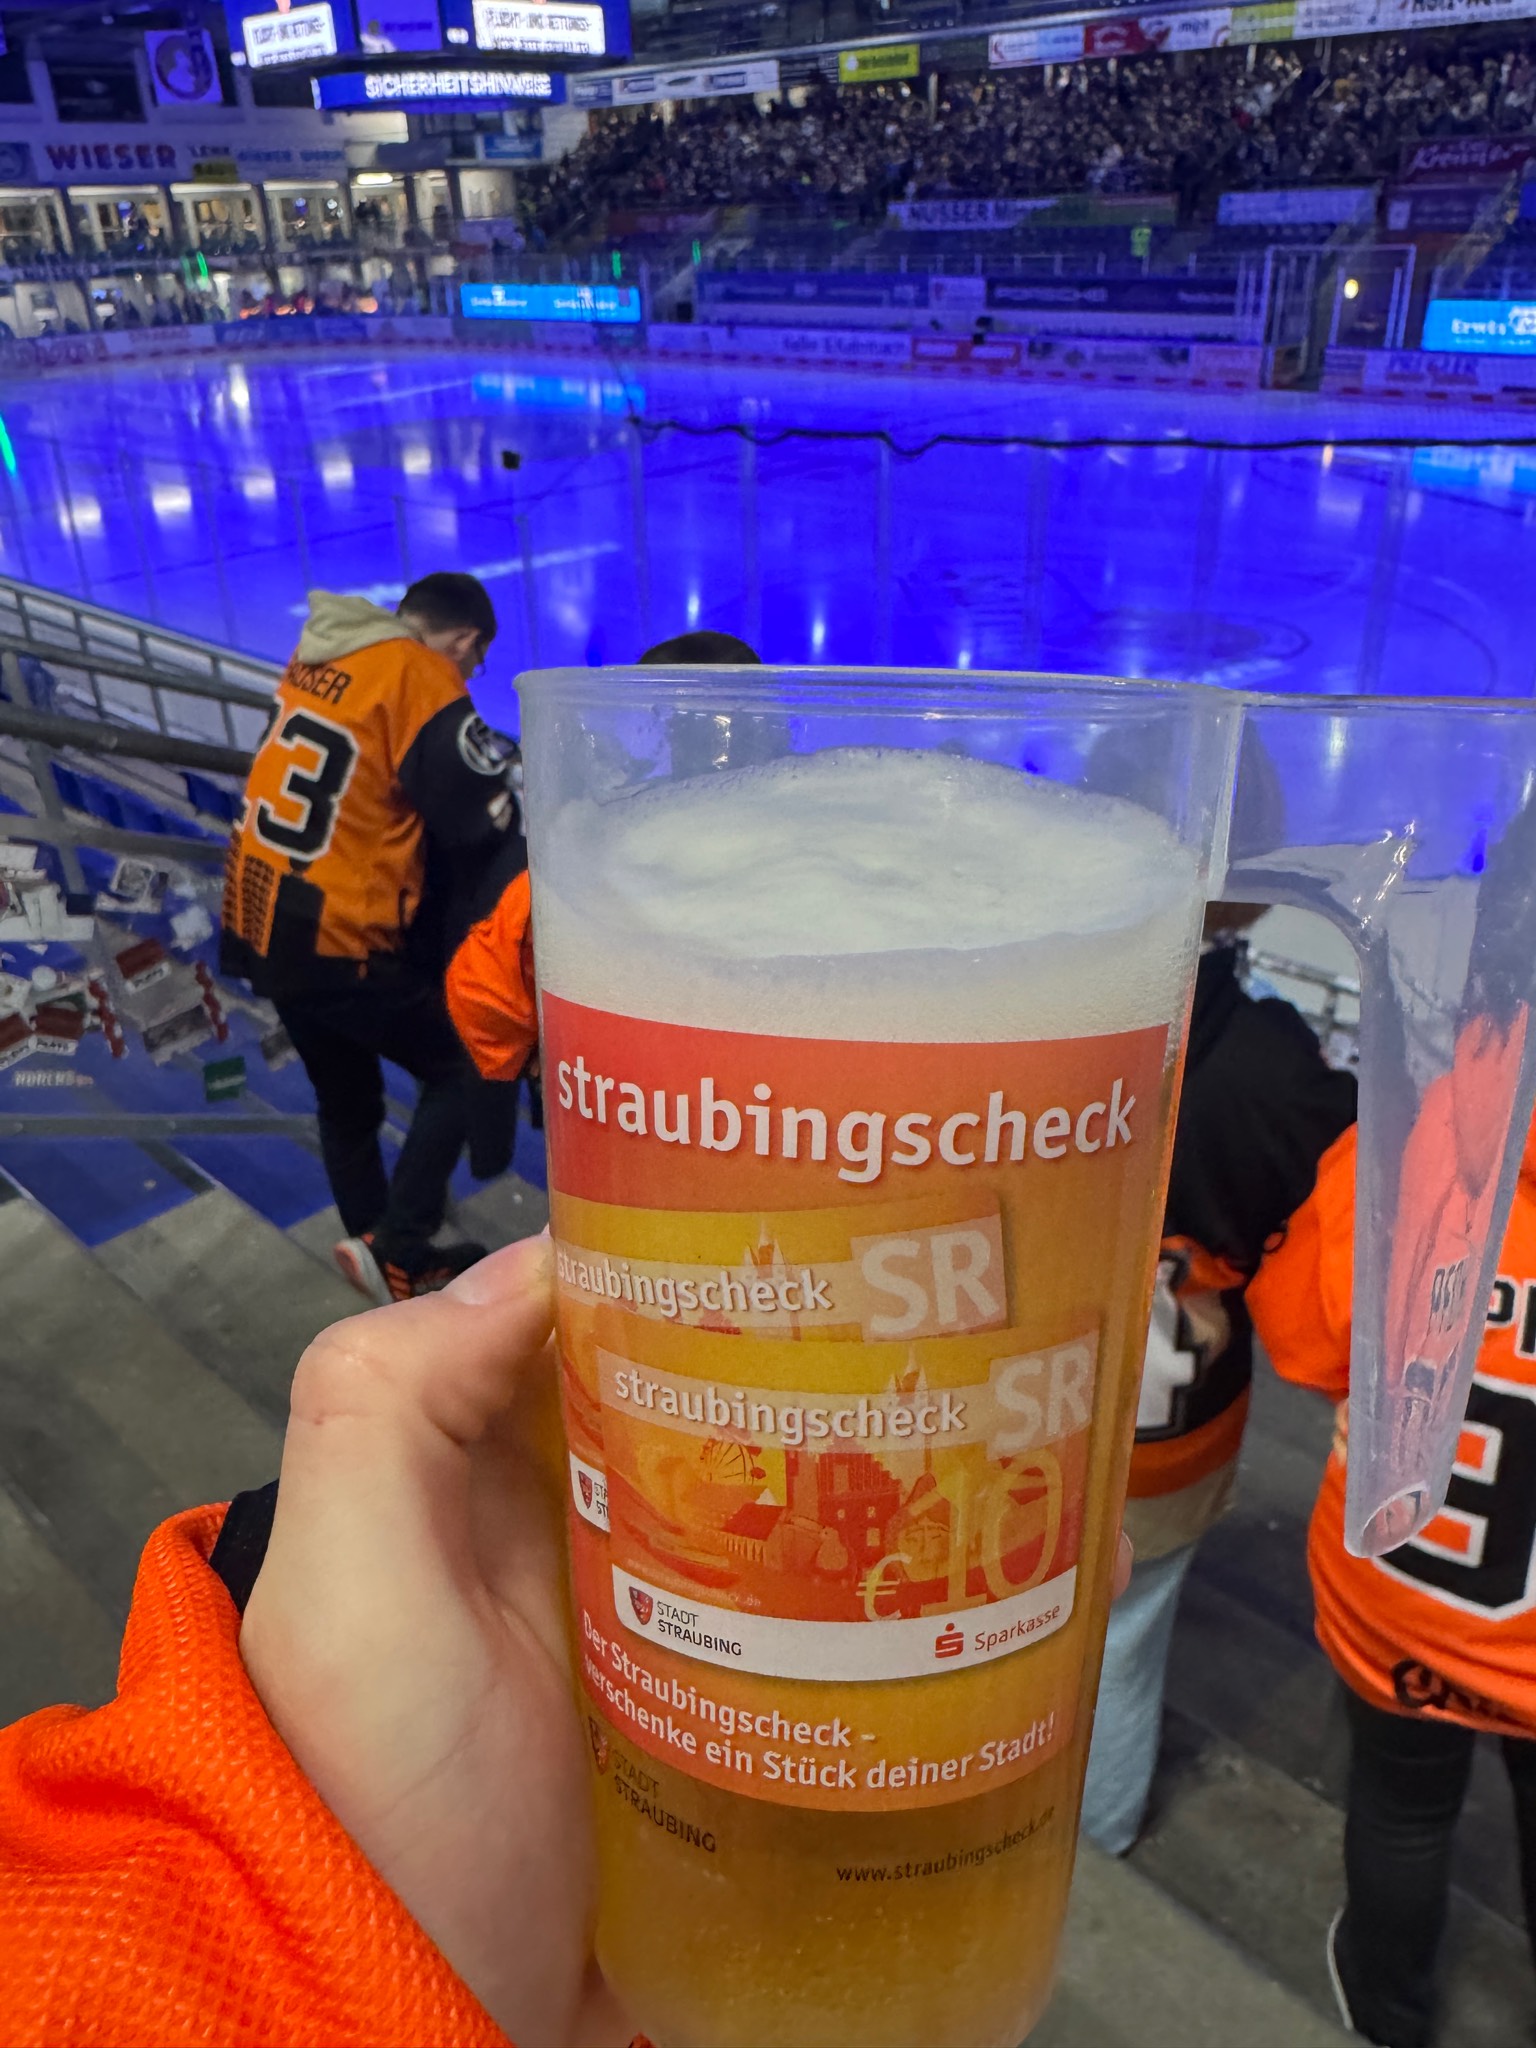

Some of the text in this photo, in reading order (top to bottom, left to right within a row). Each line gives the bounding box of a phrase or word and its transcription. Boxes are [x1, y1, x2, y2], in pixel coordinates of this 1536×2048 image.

[45, 142, 177, 171] WIESER
[236, 696, 360, 862] 3
[558, 1055, 1136, 1183] straubingscheck
[556, 1248, 834, 1318] straubingscheck
[861, 1230, 999, 1333] SR
[614, 1369, 967, 1445] straubingscheck
[995, 1345, 1090, 1450] SR
[656, 1601, 699, 1628] STADT
[657, 1619, 742, 1656] STRAUBING
[974, 1605, 1061, 1652] Sparkasse
[583, 1608, 608, 1659] Der
[610, 1641, 852, 1748] Straubingscheck
[584, 1653, 1056, 1789] verschenke ein Stück deiner Stadt!
[614, 1751, 660, 1799] STADT
[614, 1774, 717, 1853] STRAUBING
